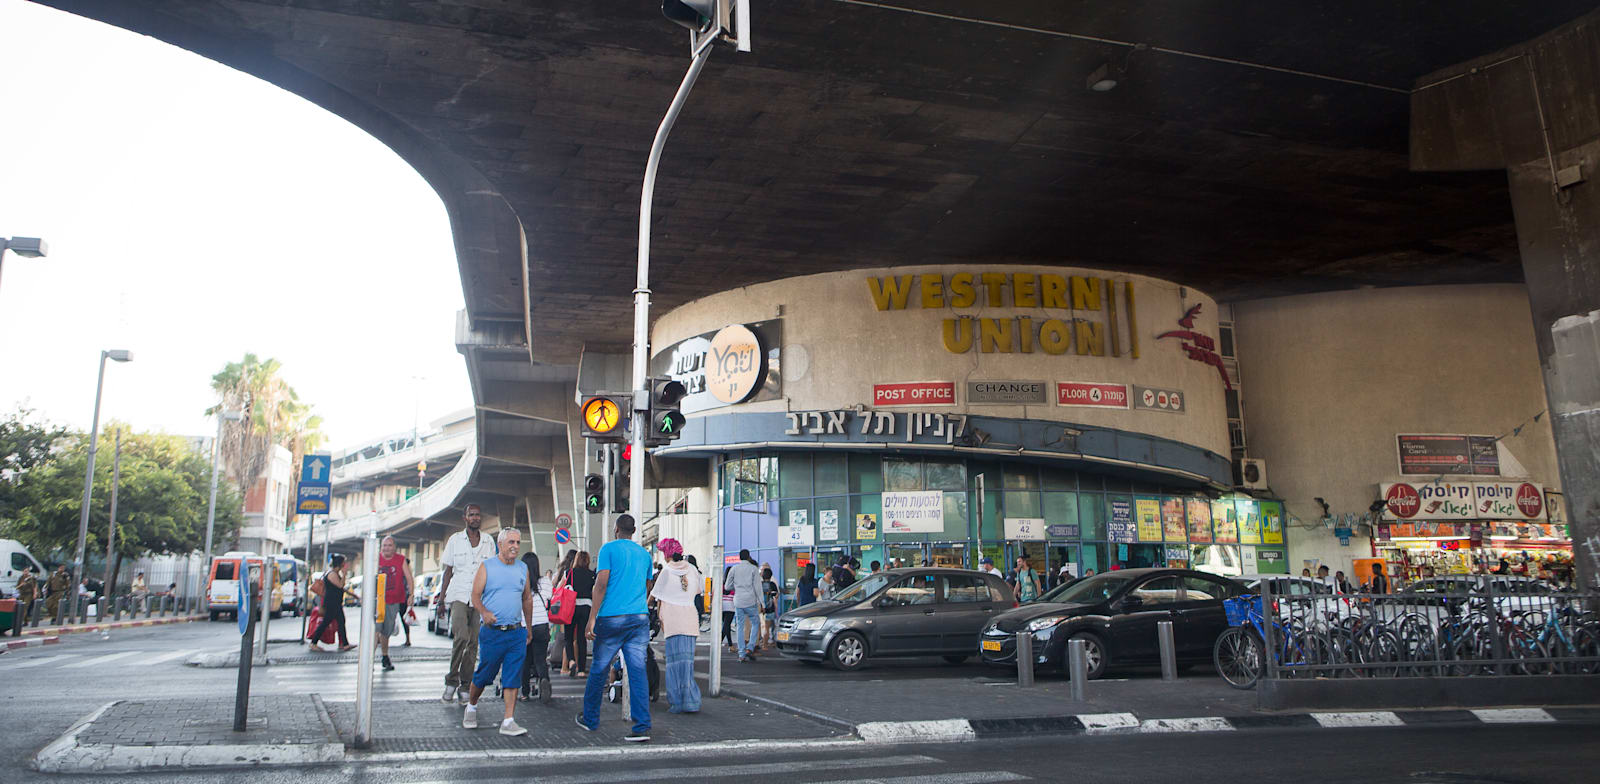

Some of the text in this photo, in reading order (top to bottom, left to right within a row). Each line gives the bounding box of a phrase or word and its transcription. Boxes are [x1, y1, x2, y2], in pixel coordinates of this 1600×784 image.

[866, 272, 1101, 312] WESTERN
[943, 317, 1106, 357] UNION
[876, 388, 952, 400] POST OFFICE
[975, 383, 1040, 393] CHANGE
[1061, 389, 1125, 402] FLOOR 4 קומה
[784, 404, 967, 444] קניון תל אביב
[1423, 484, 1470, 499] קיוסק
[1476, 484, 1513, 499] קיוסק
[884, 492, 941, 508] להסעות חיילים
[885, 510, 905, 519] 106-111
[1441, 500, 1473, 516] יגאל
[1492, 500, 1516, 516] יגאל
[927, 510, 941, 520] קומה
[558, 518, 569, 526] 30
[1020, 525, 1030, 533] 42
[791, 532, 801, 540] 43
[1108, 531, 1115, 541] 6
